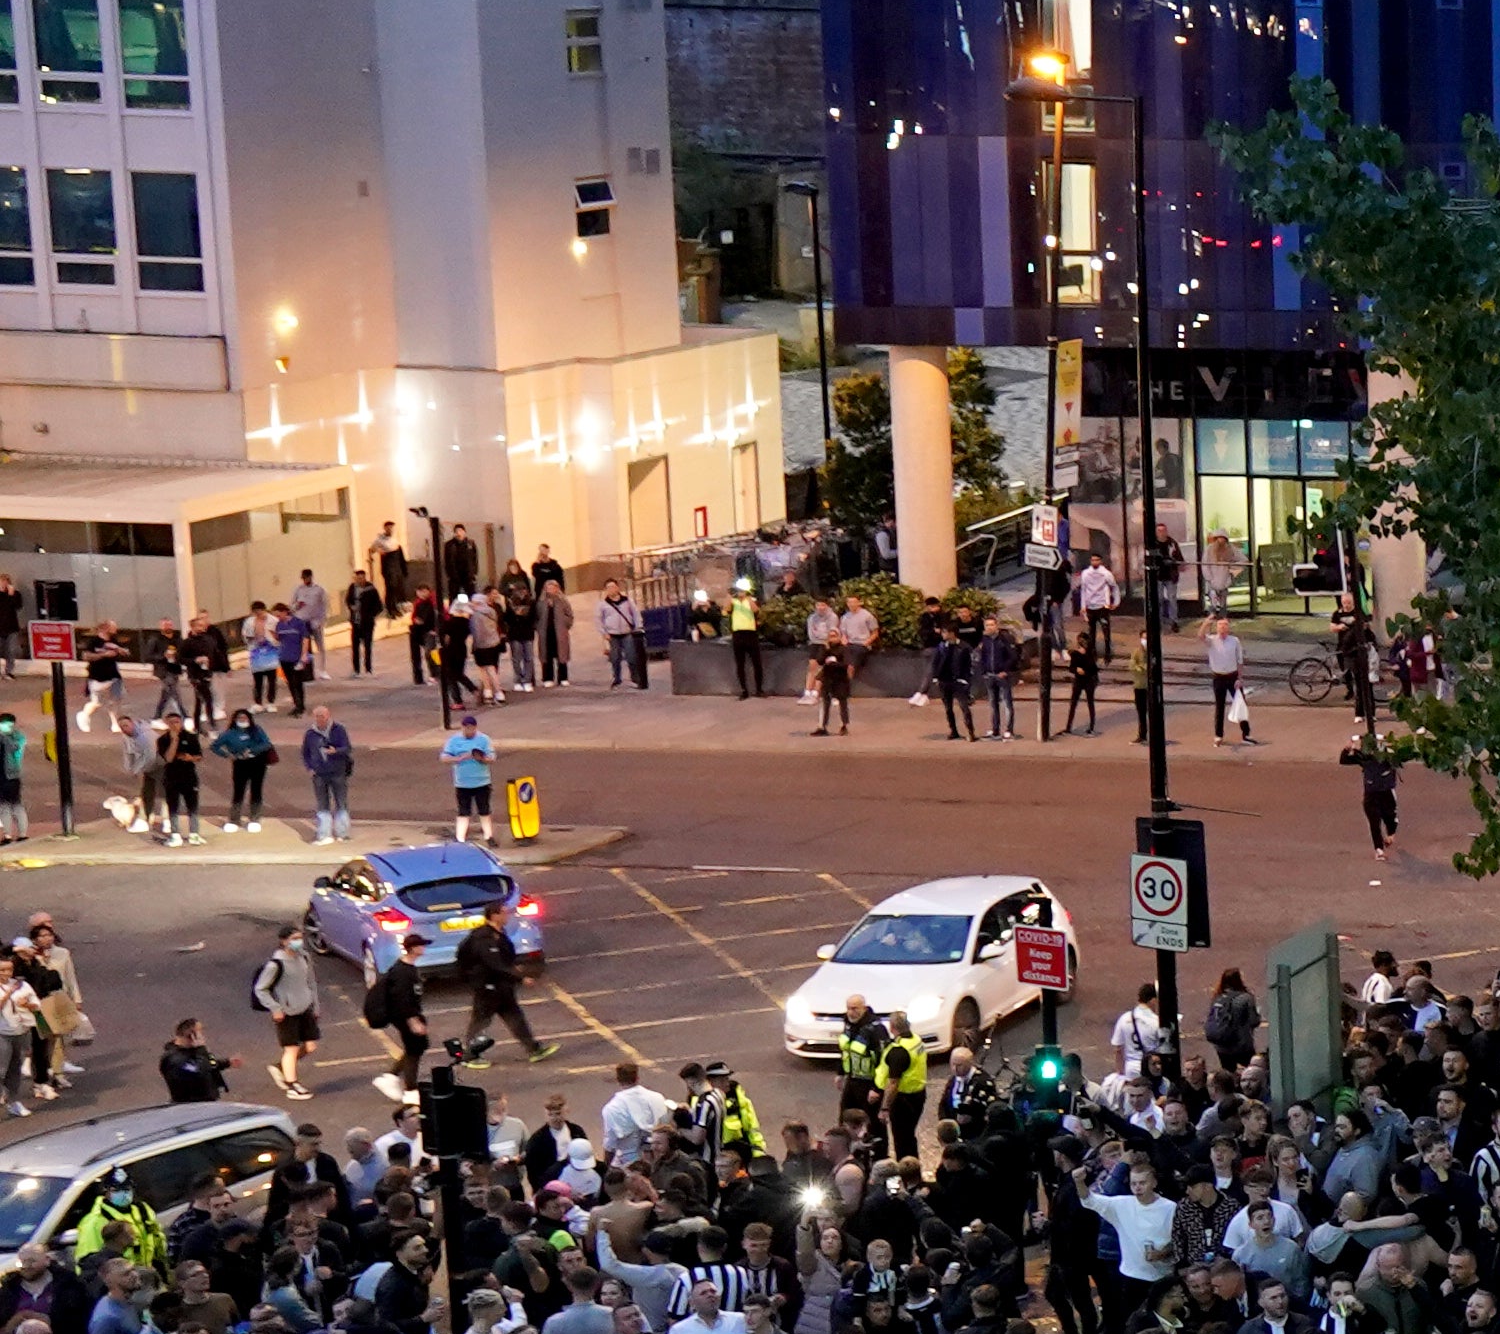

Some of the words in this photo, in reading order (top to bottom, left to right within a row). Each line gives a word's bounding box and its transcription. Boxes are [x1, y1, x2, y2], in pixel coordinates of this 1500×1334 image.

[1143, 877, 1175, 901] 30
[1161, 927, 1178, 935] Zone
[1018, 930, 1062, 946] COVID-19
[1156, 935, 1184, 948] ENDS
[1029, 948, 1053, 961] Keep
